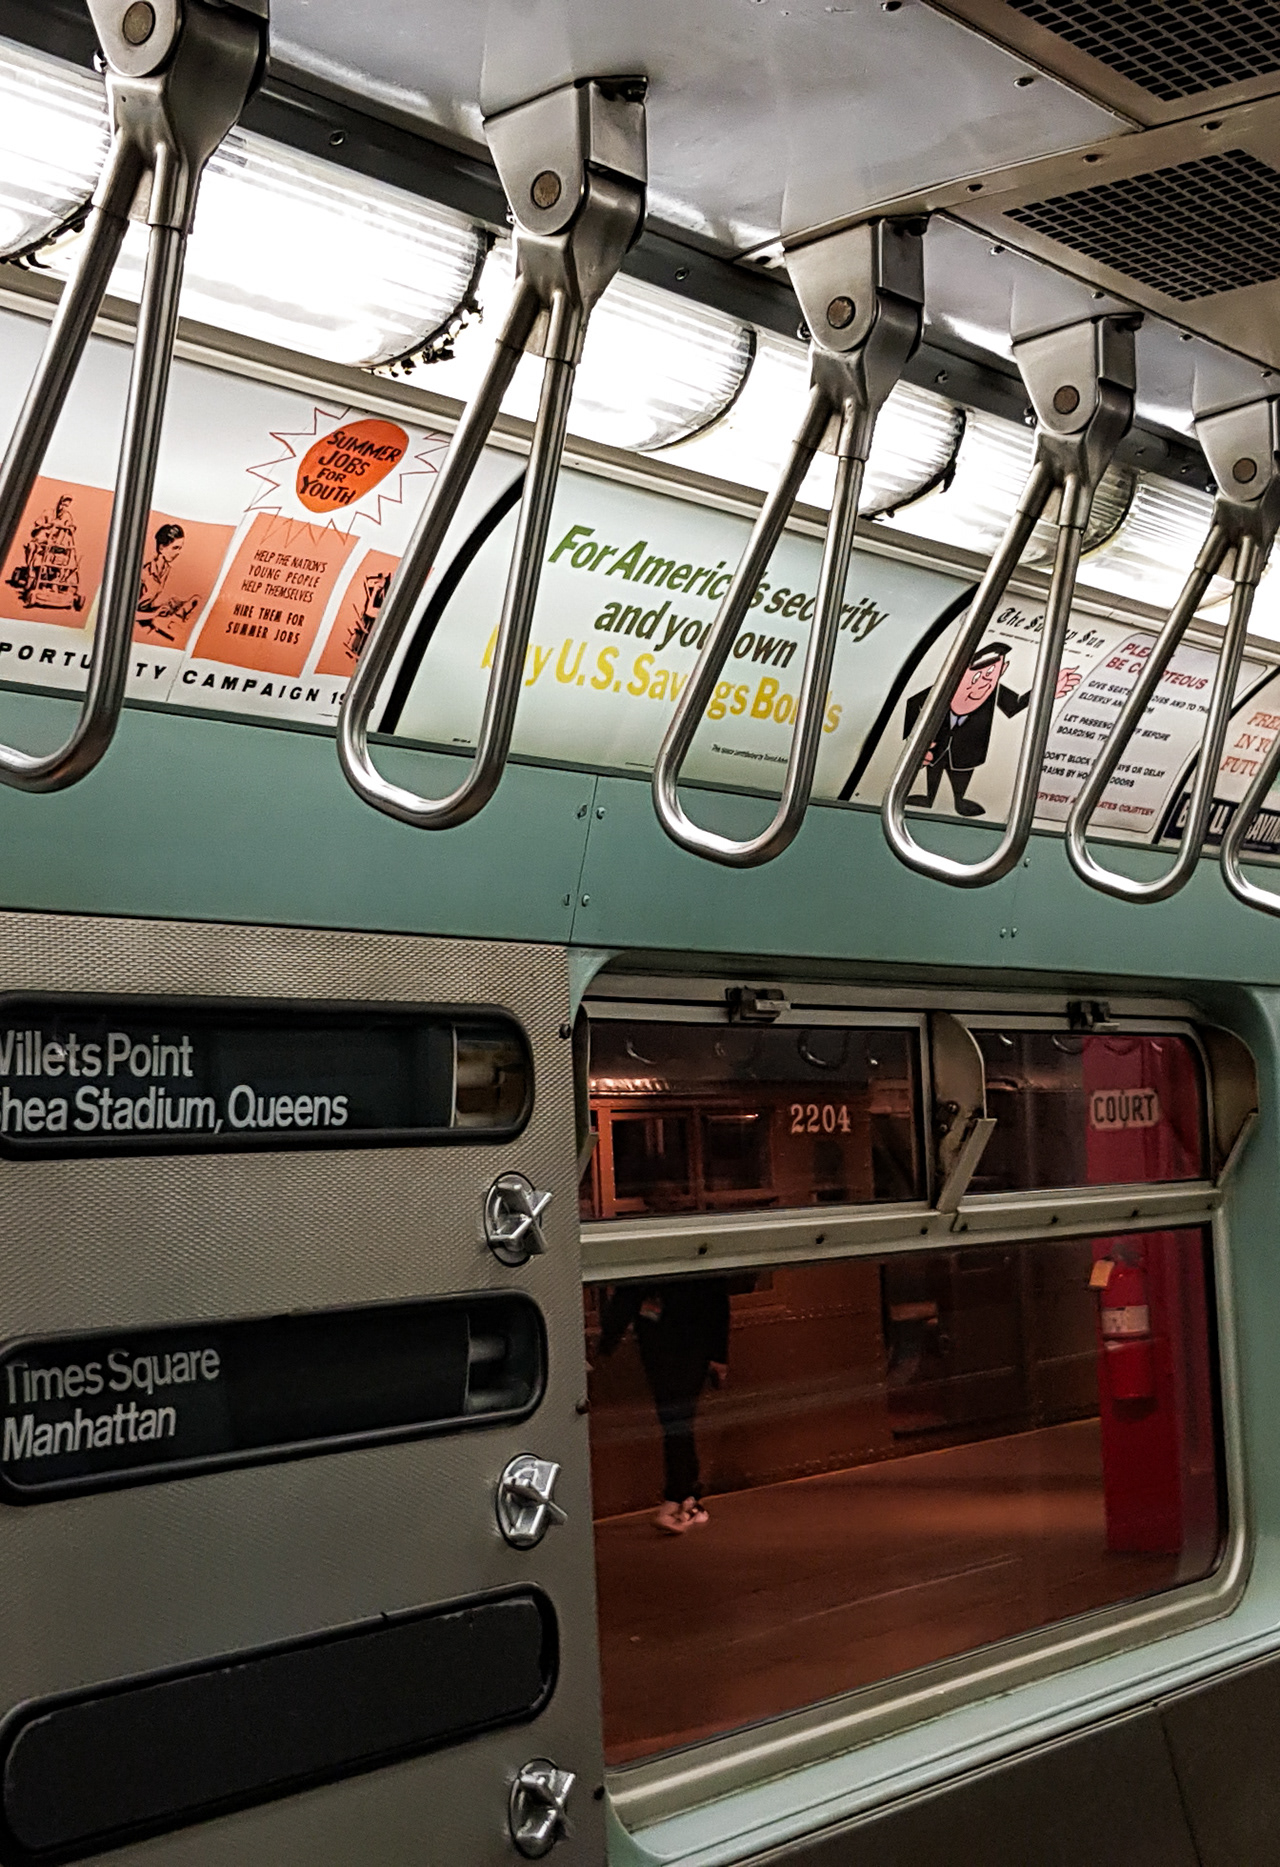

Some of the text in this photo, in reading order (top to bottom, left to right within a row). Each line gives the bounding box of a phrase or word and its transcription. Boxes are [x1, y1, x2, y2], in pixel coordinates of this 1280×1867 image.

[327, 431, 402, 462] SUMMER
[317, 468, 347, 483] FOR
[318, 451, 370, 477] JOBS
[299, 475, 356, 505] YOUTH
[254, 549, 328, 573] HELP THE NATION'S
[249, 564, 321, 588] YOUNG PEOPLE
[548, 525, 616, 576] For
[764, 588, 890, 642] secrity
[241, 579, 314, 604] HELP THEMSELVES
[233, 603, 305, 627] HIRE THEM FOR
[997, 607, 1025, 628] The
[1077, 629, 1105, 649] Sun
[226, 621, 300, 645] SUMMER JOBS
[594, 600, 671, 642] and
[733, 632, 798, 668] own
[555, 638, 621, 693] U.S.
[1106, 657, 1129, 670] BE
[182, 669, 320, 703] CAMPAIGN
[1078, 691, 1111, 705] ELDERLY
[1088, 680, 1106, 690] GIVE
[1170, 699, 1186, 709] AND
[1056, 725, 1096, 740] BOARDING
[1064, 713, 1079, 722] LET
[1141, 729, 1171, 742] BEFORE
[1234, 733, 1255, 750] IN
[1041, 765, 1065, 777] RAINS
[1067, 753, 1091, 766] BLOCK
[1142, 767, 1165, 778] DELAY
[107, 1033, 194, 1079] Point
[74, 1085, 223, 1135] Stadium,
[228, 1085, 349, 1131] Queens
[790, 1103, 852, 1135] 2204
[1093, 1095, 1156, 1124] COURT
[5, 1348, 220, 1404] Times Square
[2, 1404, 177, 1462] Manhattan
